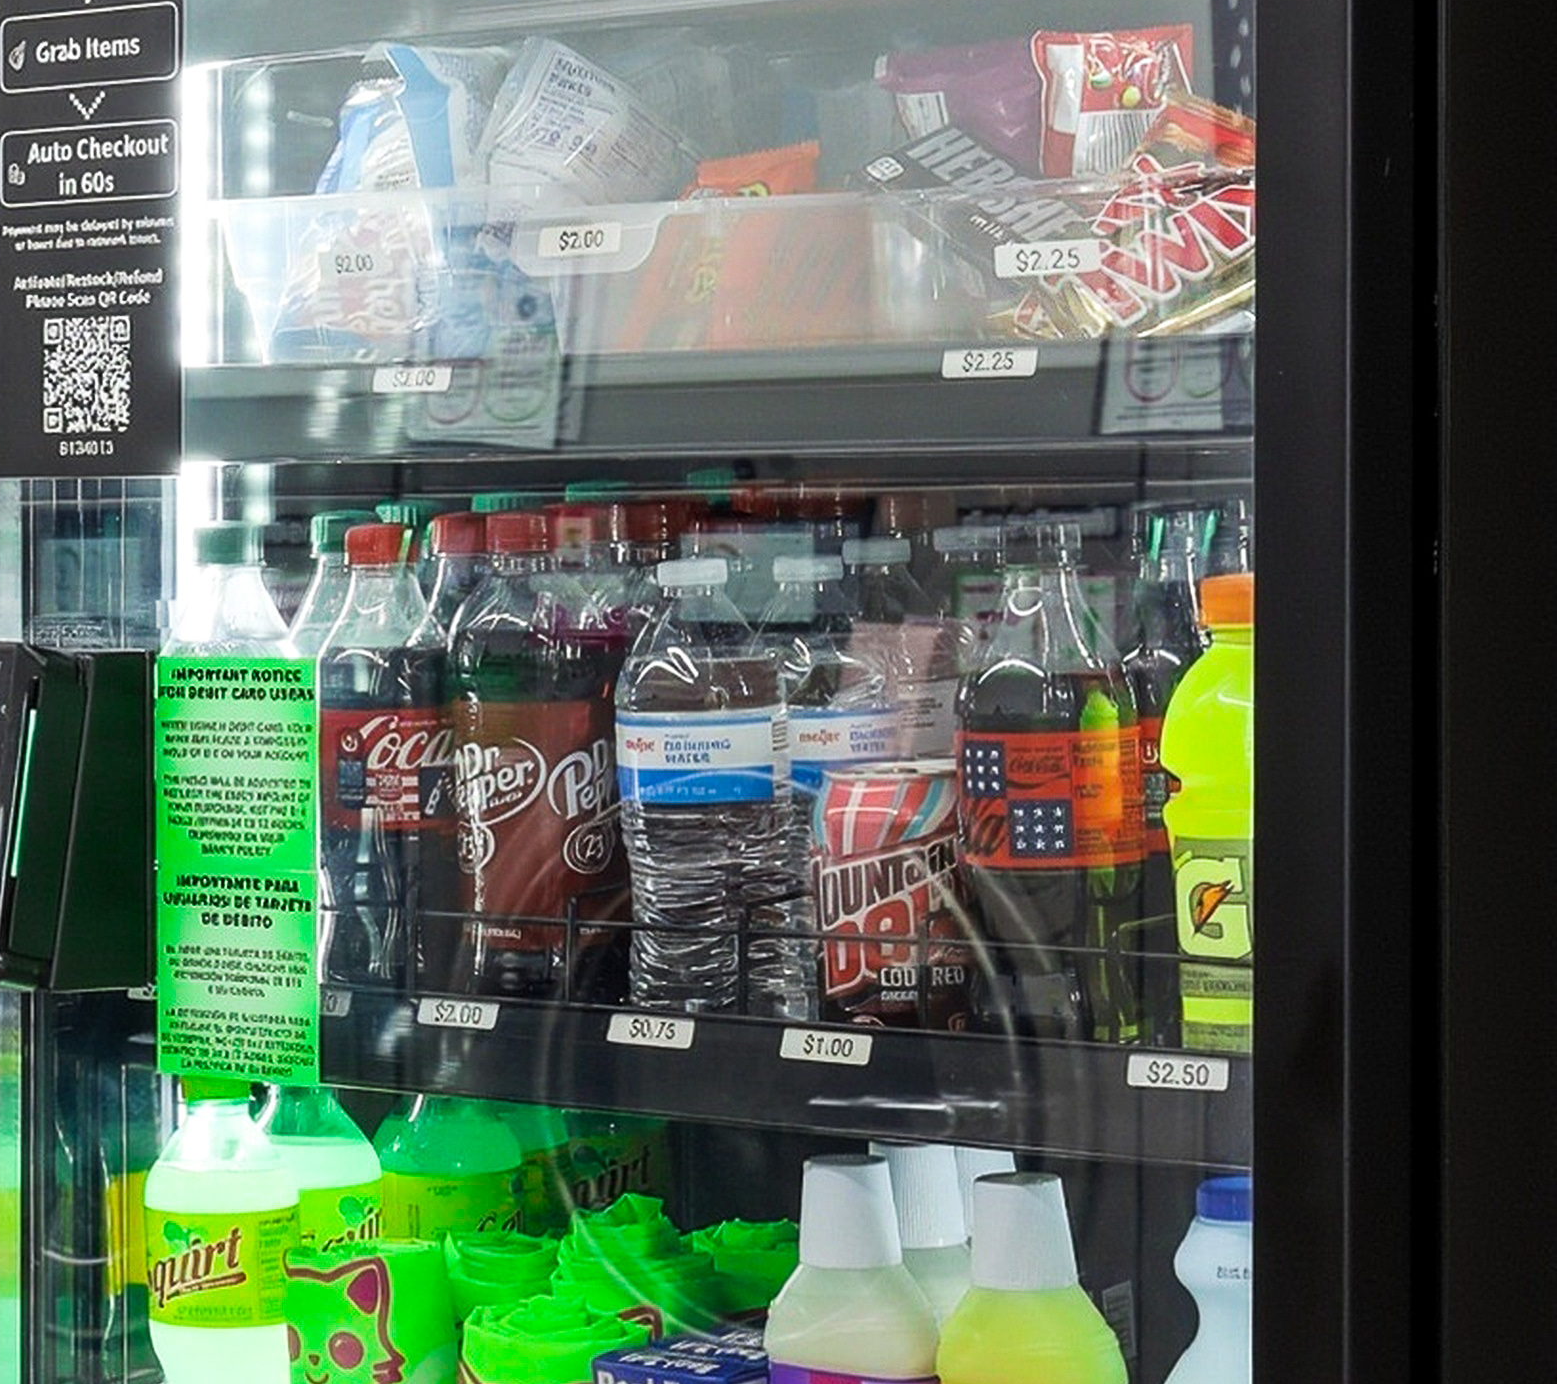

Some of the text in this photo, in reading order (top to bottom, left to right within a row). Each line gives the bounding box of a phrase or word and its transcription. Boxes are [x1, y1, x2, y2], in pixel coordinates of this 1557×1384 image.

[35, 36, 141, 63] Grab Items
[28, 134, 169, 164] Auto Checkout
[59, 171, 115, 196] in 60s
[558, 228, 605, 251] $2.00
[334, 253, 374, 274] $2.00
[1014, 249, 1081, 272] $2.25
[961, 353, 1015, 372] $2.25
[434, 998, 482, 1026] $2.00
[629, 1020, 676, 1041] $0.75
[802, 1036, 853, 1058] $1.00
[1145, 1059, 1209, 1085] $2.50
